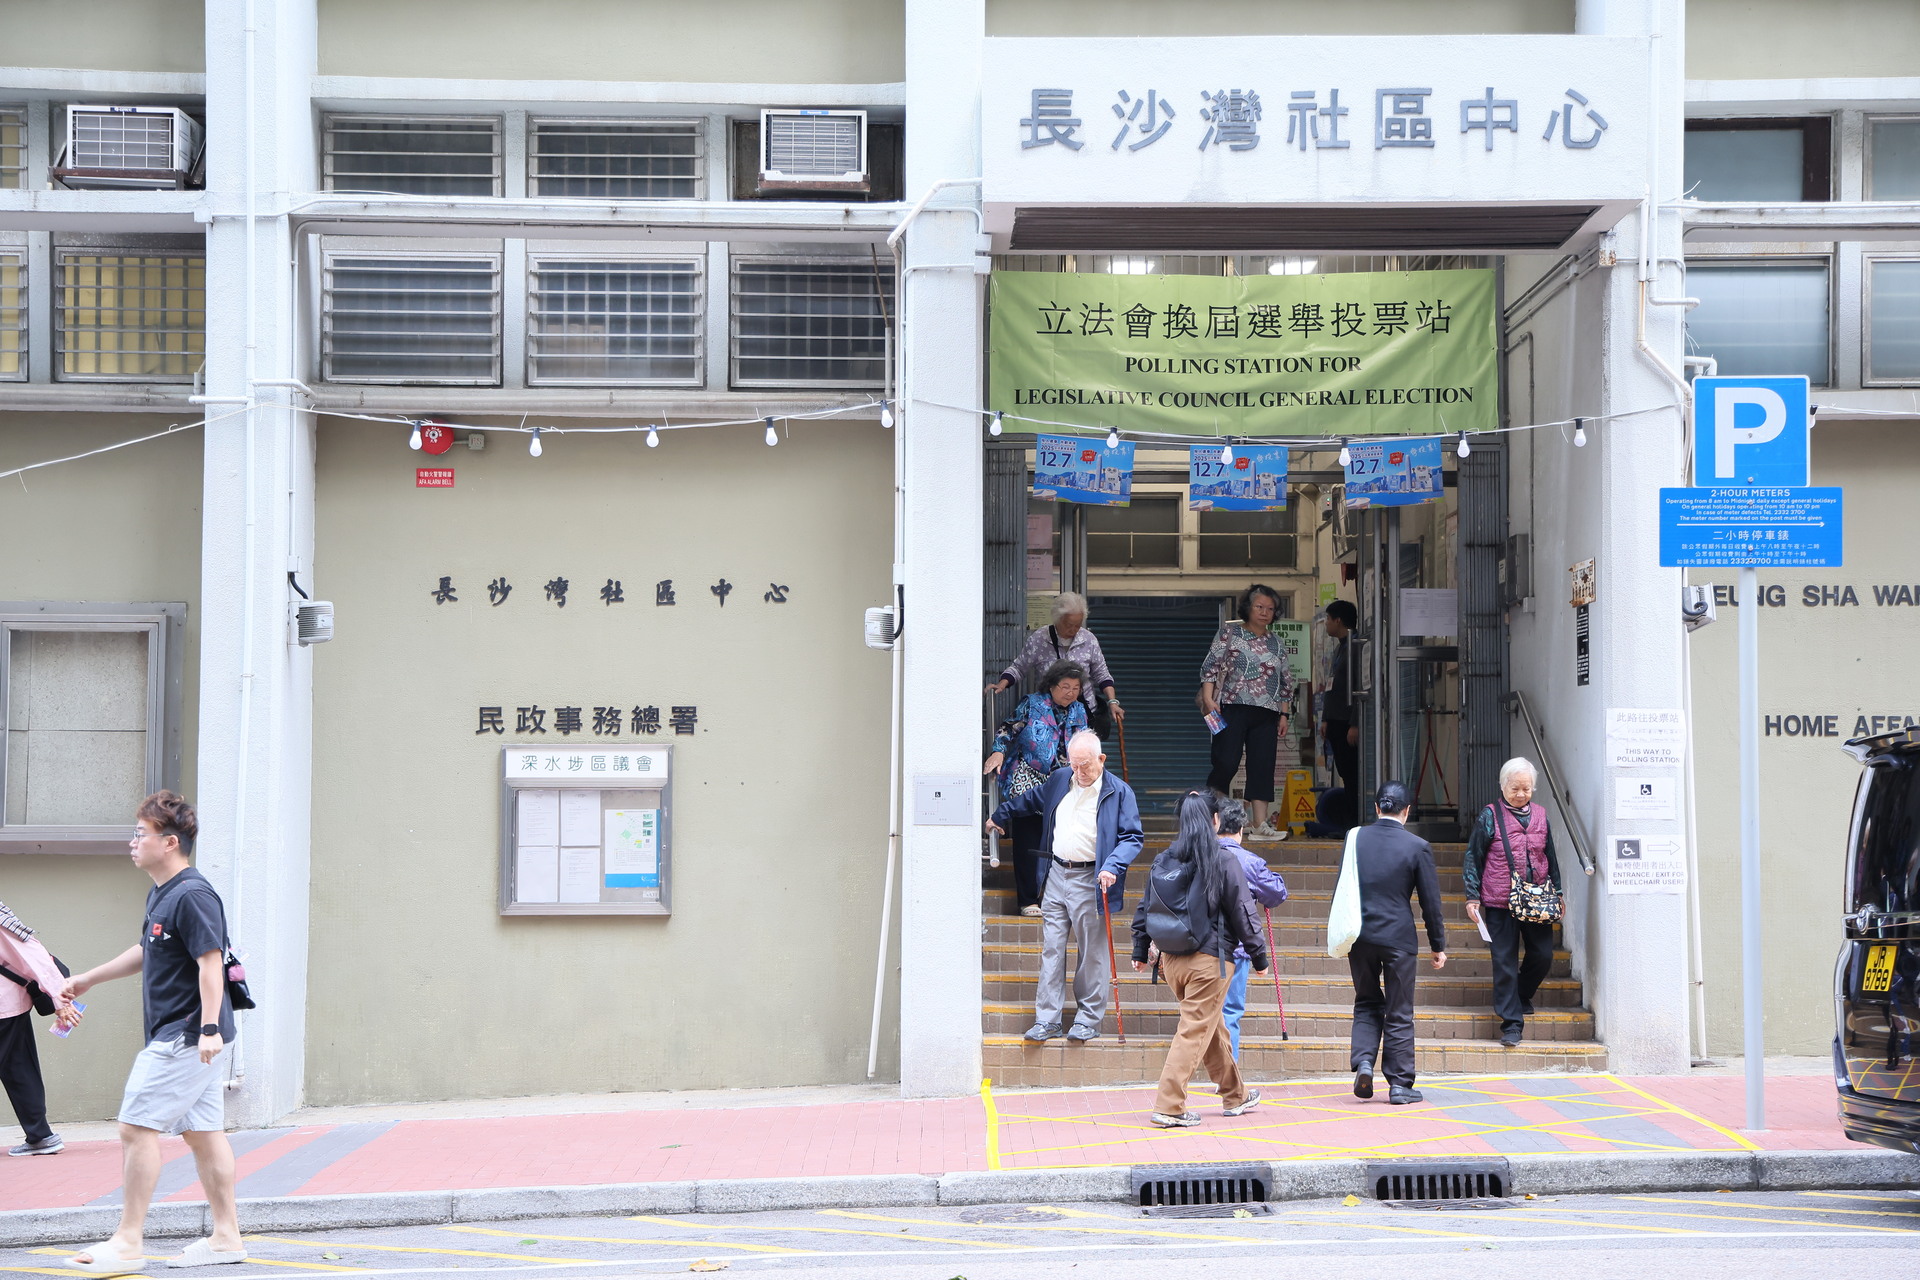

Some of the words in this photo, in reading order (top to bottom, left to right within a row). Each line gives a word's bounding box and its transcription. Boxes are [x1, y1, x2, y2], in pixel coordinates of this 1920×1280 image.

[1020, 87, 1609, 151] 長沙灣社區中心
[1036, 299, 1452, 340] 立法會換屆選舉投票站
[1125, 357, 1219, 374] POLLING
[1224, 356, 1313, 374] STATION
[1319, 356, 1362, 373] FOR
[1014, 388, 1153, 406] LEGISLATIVE
[1158, 391, 1256, 408] COUNCIL
[1259, 389, 1361, 408] GENERAL
[1365, 387, 1474, 405] ELECTION
[1715, 387, 1787, 479] P
[1711, 489, 1748, 497] 2-HOUR
[1752, 489, 1790, 497] METERS
[1712, 530, 1790, 541] 二小時停車錶
[431, 576, 790, 608] 長沙灣社區中心
[1802, 585, 1860, 606] SHA
[474, 704, 699, 735] 民政事務總署
[1616, 712, 1680, 723] 此路往投票站
[1764, 715, 1839, 737] HOME
[521, 755, 653, 772] 深水埗區議會
[1615, 861, 1682, 870] 輪椅使用者出入口
[1873, 946, 1887, 968] JR
